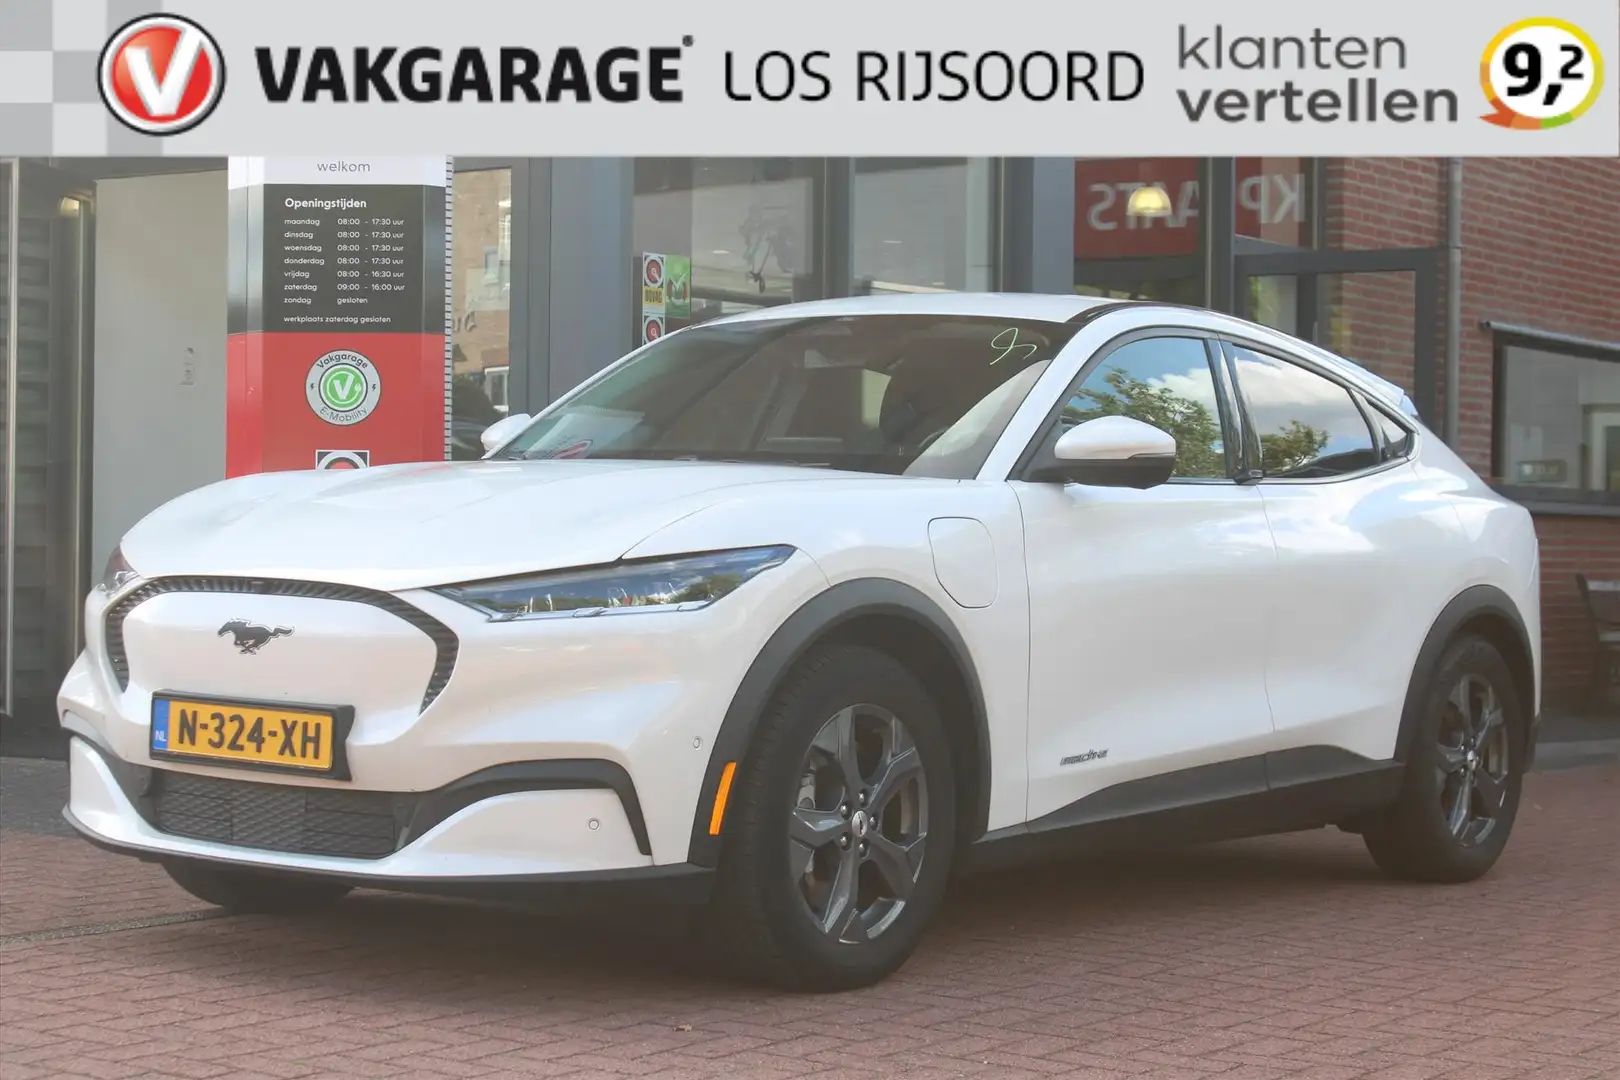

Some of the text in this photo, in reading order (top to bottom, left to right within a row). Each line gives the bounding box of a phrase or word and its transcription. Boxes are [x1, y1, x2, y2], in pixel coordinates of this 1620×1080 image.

[316, 160, 371, 172] welkom
[284, 197, 367, 211] Openingstijden
[283, 218, 320, 227] maandag
[337, 218, 361, 226] 08:00
[371, 218, 391, 226] 17:30
[283, 231, 314, 240] dinsdag
[337, 231, 361, 239] 08:00
[371, 231, 391, 239] 17:30
[283, 244, 322, 253] woensdag
[337, 244, 361, 252] 08:00
[371, 244, 391, 252] 17:30
[283, 257, 325, 266] donderdag
[337, 257, 361, 265] 08:00
[371, 257, 391, 265] 17:30
[283, 271, 310, 280] vrijdag
[337, 271, 361, 279] 08:00
[371, 271, 391, 279] 16:30
[283, 284, 318, 293] zaterdag
[337, 284, 361, 292] 09:00
[371, 284, 392, 292] 16:00
[283, 297, 368, 306] zondag gesloten
[283, 315, 392, 325] werkplaats zaterdag gesloten
[316, 353, 368, 369] Vakgarage
[319, 406, 368, 421] E-Mobility
[154, 729, 167, 742] NL
[178, 708, 321, 760] N-324-XH
